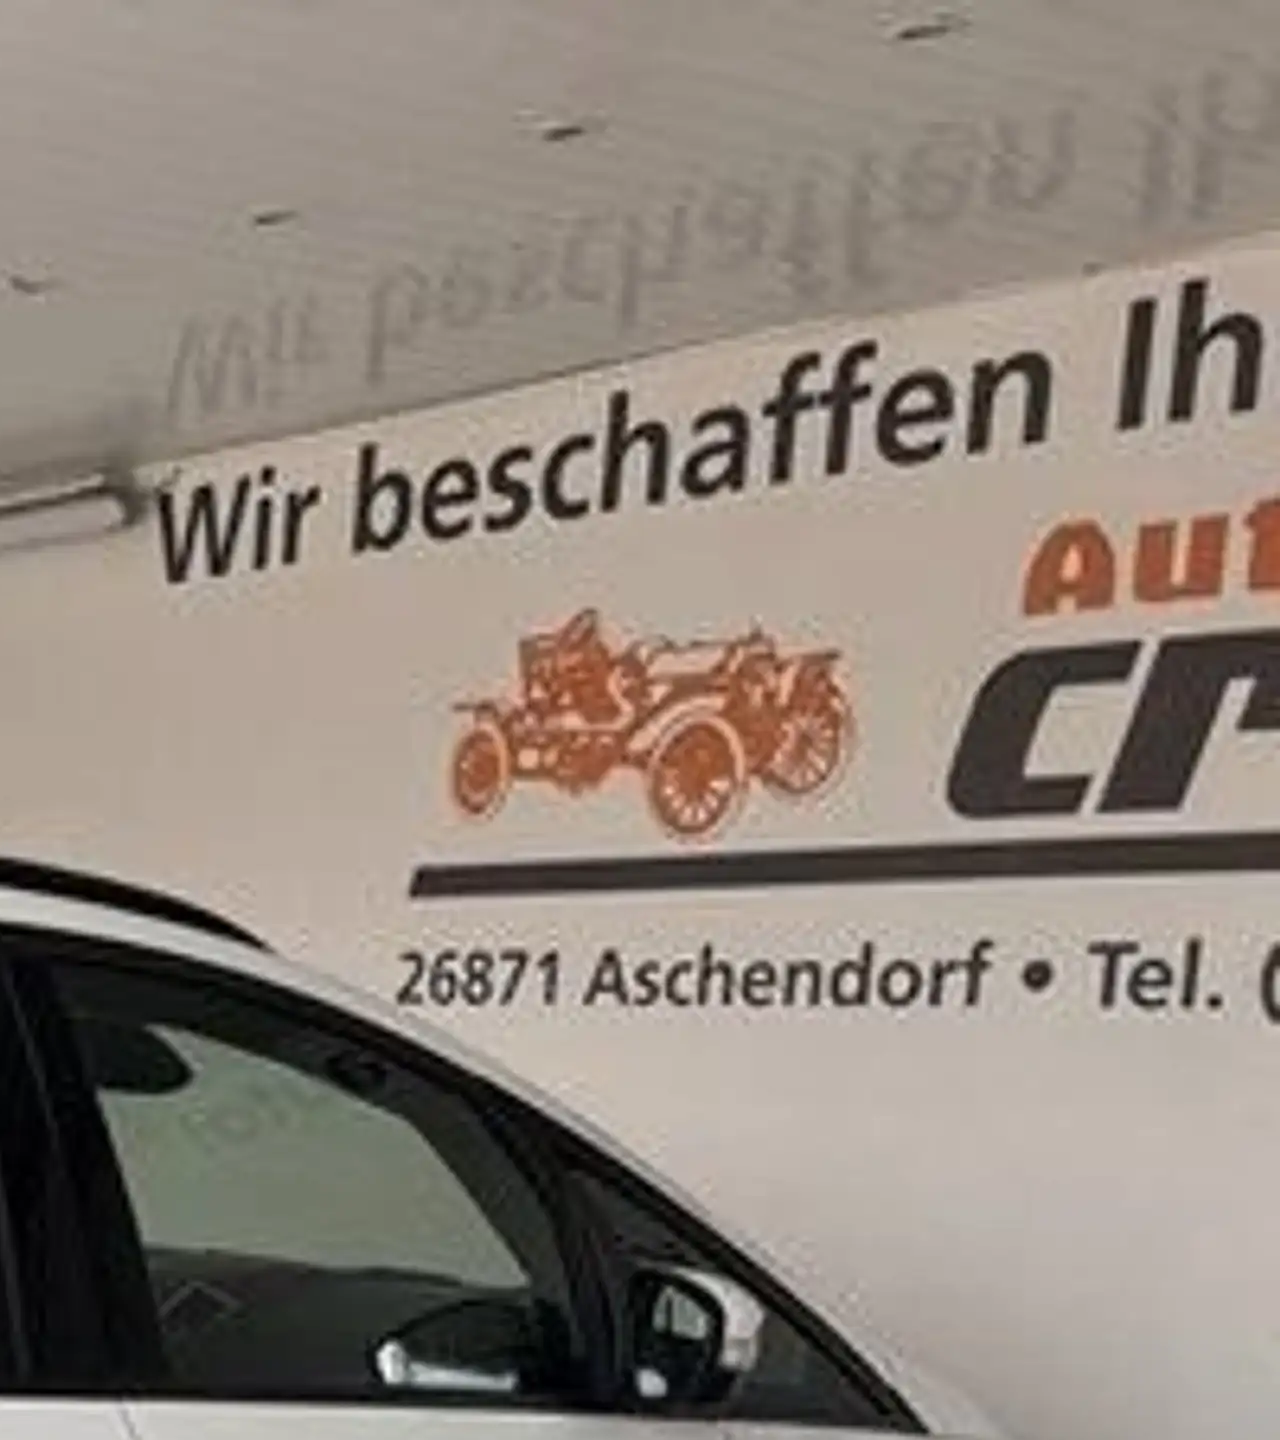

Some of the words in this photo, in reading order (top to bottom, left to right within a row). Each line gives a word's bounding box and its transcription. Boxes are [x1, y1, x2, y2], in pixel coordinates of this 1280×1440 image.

[154, 466, 321, 585] Wir
[351, 340, 1054, 556] beschaffen
[1117, 278, 1264, 432] Ih
[396, 950, 559, 1006] 26871
[583, 939, 994, 1007] Aschendorf
[1087, 938, 1223, 1010] Tel.
